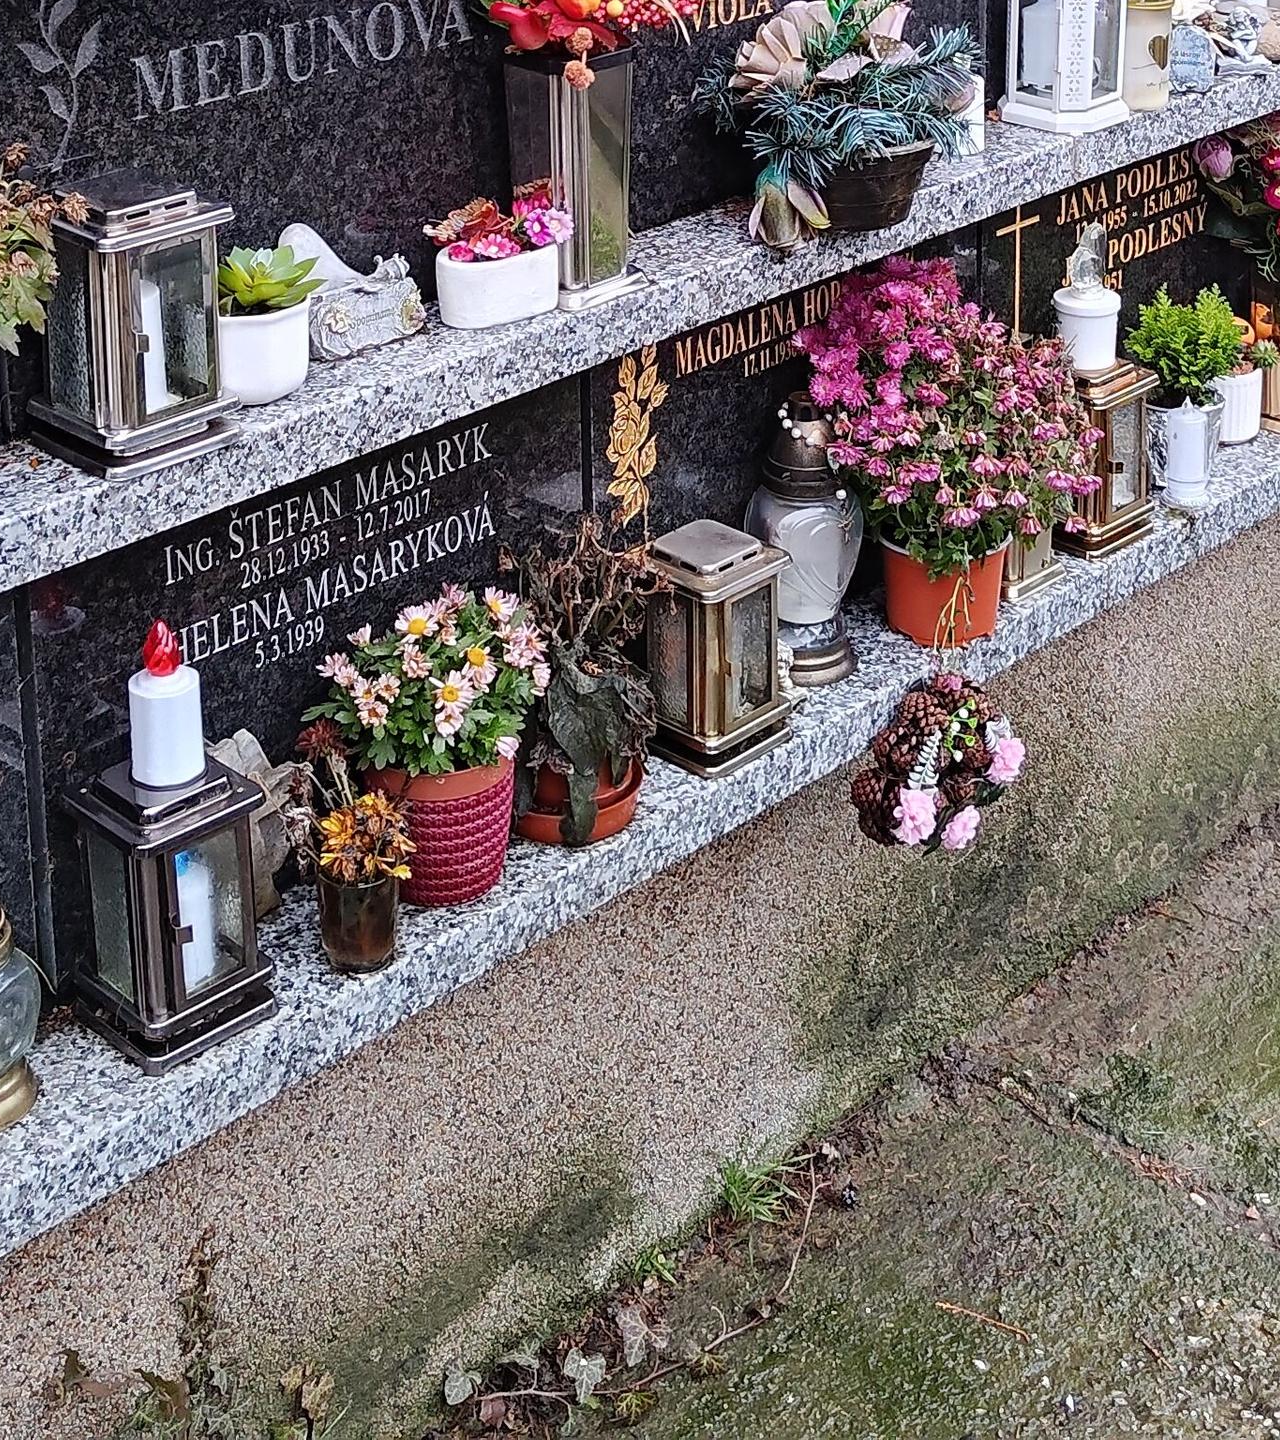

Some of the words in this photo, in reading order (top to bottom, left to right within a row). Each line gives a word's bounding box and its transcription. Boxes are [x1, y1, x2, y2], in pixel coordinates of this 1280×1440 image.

[1056, 177, 1109, 227] JANA
[1115, 148, 1196, 204] PODLES
[1142, 178, 1199, 219] 15.10.2022
[1107, 193, 1208, 269] PODLESNÝ
[162, 544, 221, 587] ING.
[228, 479, 344, 563] ŠTEFAN
[354, 422, 493, 512] MASARYK
[239, 530, 331, 591] 28.12.1933
[355, 488, 431, 543] 12.7.2017
[177, 591, 297, 667] HELENA
[303, 490, 498, 616] MASARYKOVÁ
[253, 615, 326, 670] 5.3.1939
